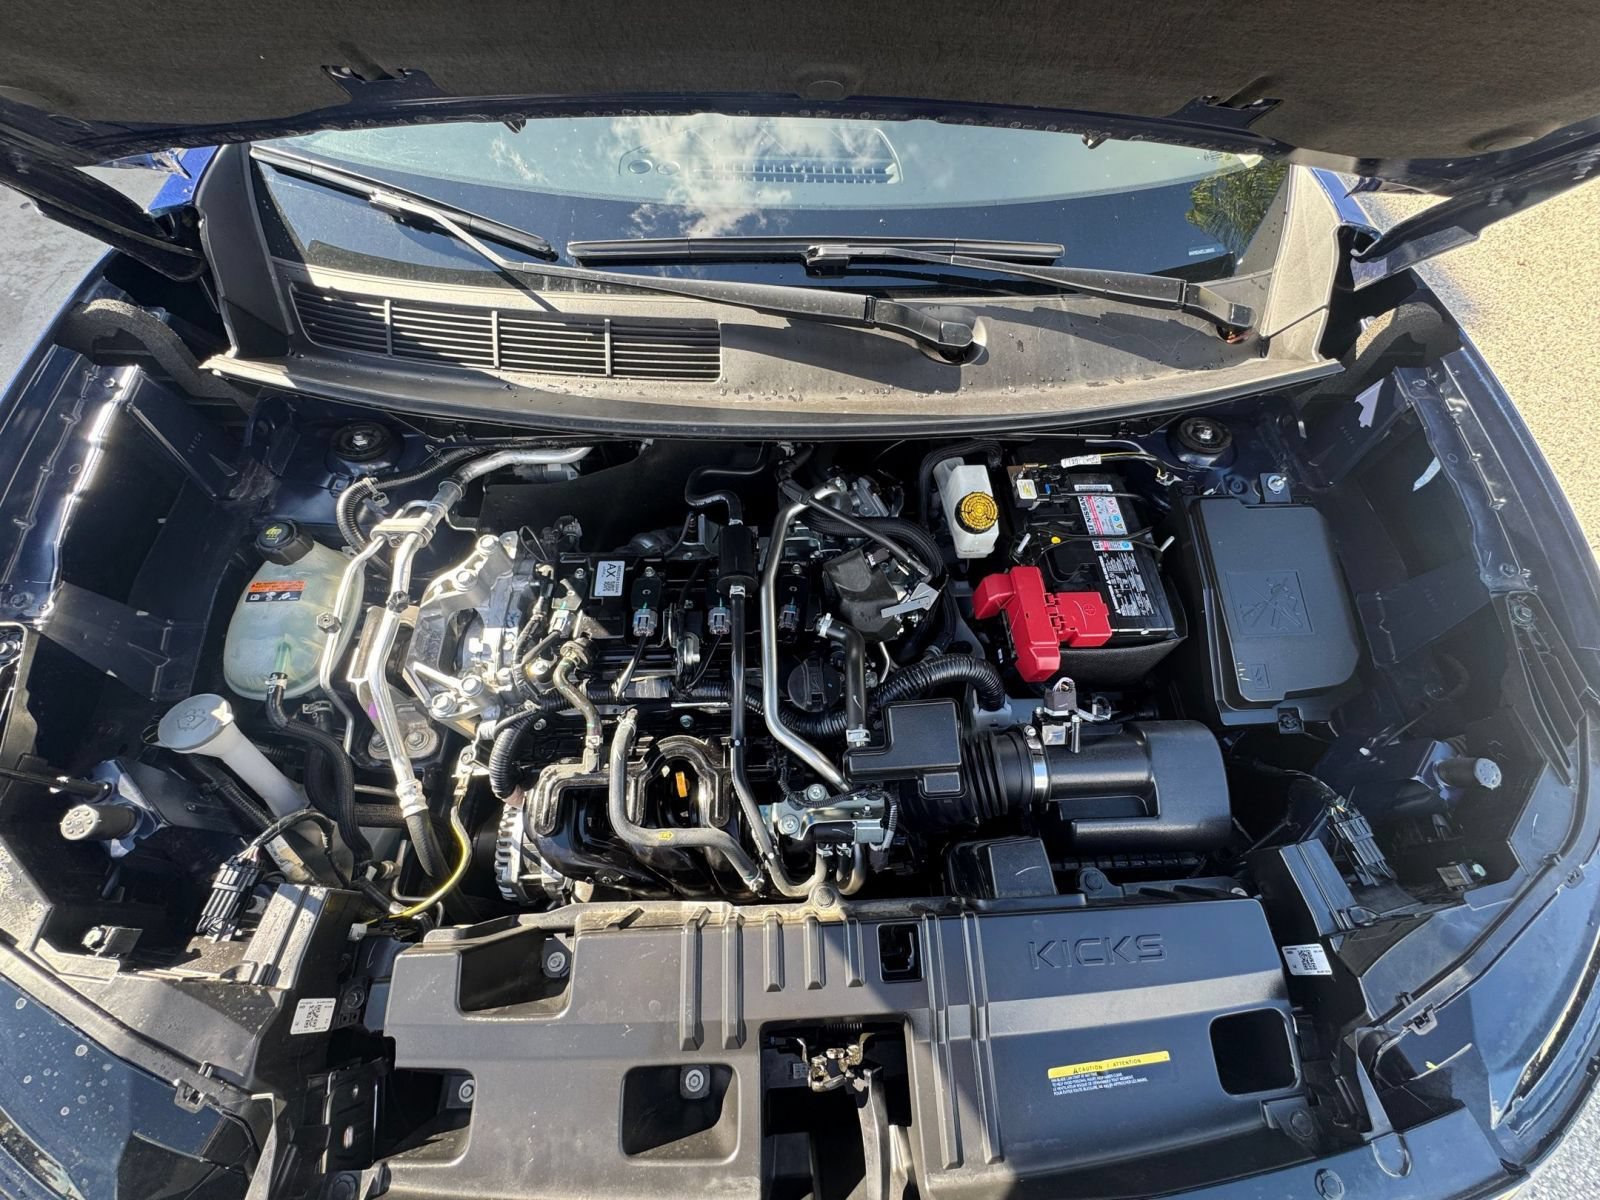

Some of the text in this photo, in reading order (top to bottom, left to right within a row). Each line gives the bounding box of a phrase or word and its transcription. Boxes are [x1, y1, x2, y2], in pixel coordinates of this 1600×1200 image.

[1079, 496, 1091, 523] NISSAN
[606, 563, 617, 577] AX
[1028, 933, 1168, 970] KICKS
[1079, 1065, 1103, 1073] CAUTION
[1113, 1058, 1142, 1067] ATTENTION
